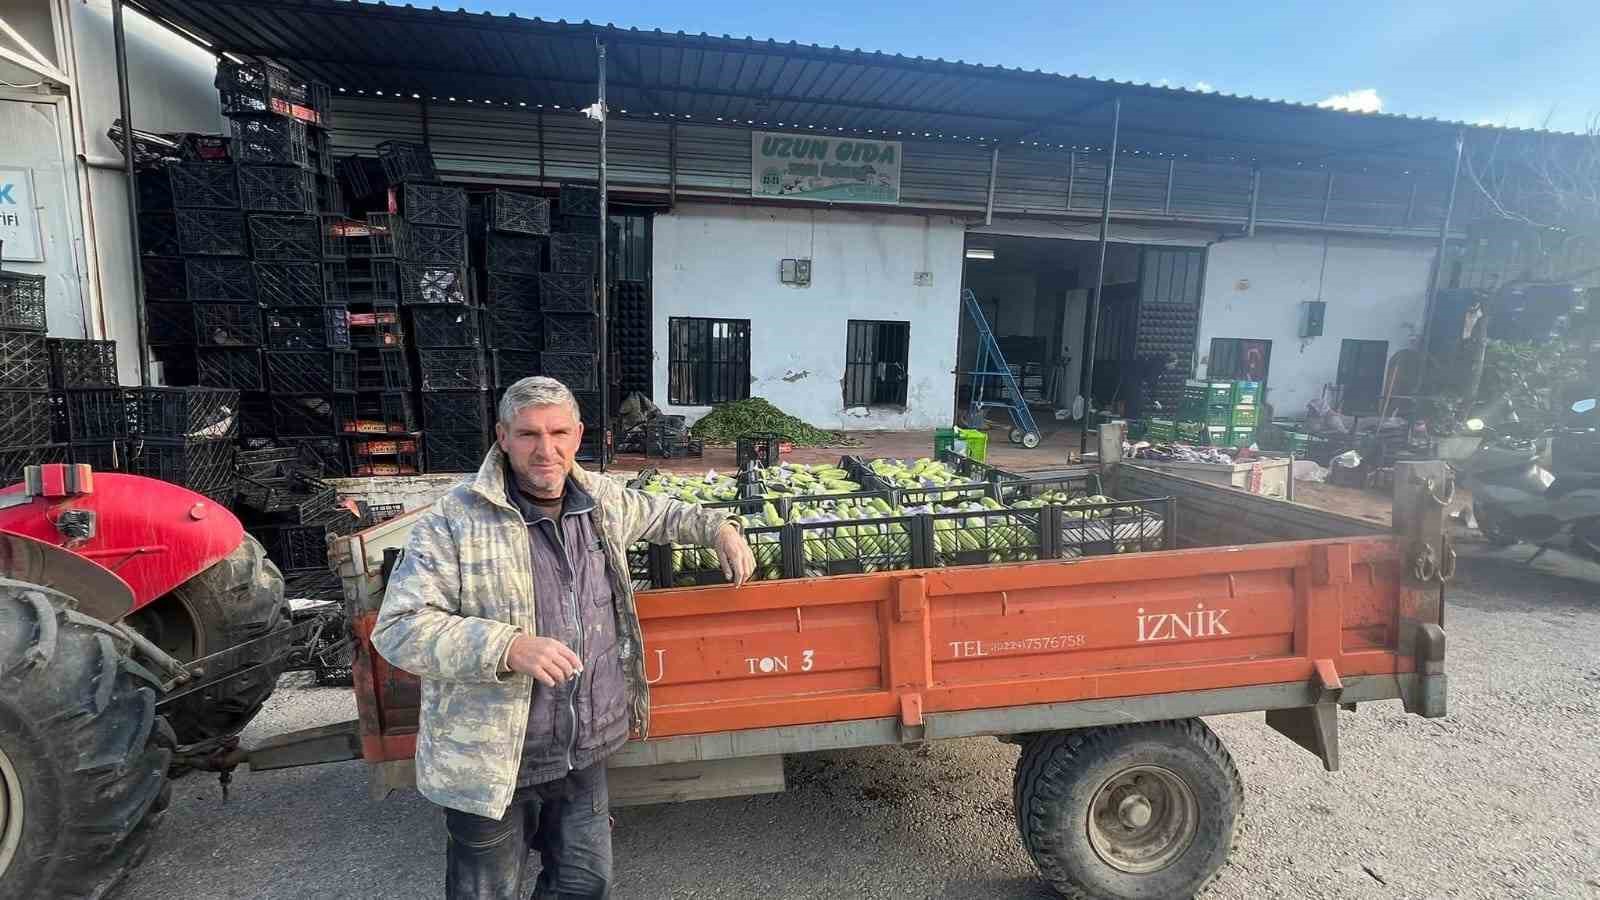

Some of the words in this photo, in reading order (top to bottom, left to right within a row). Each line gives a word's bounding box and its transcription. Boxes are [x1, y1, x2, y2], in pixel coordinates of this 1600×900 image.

[761, 135, 829, 160] UZUN
[1136, 603, 1231, 641] İZNİK
[744, 656, 789, 674] TON
[801, 649, 815, 672] 3
[949, 640, 989, 658] TEL
